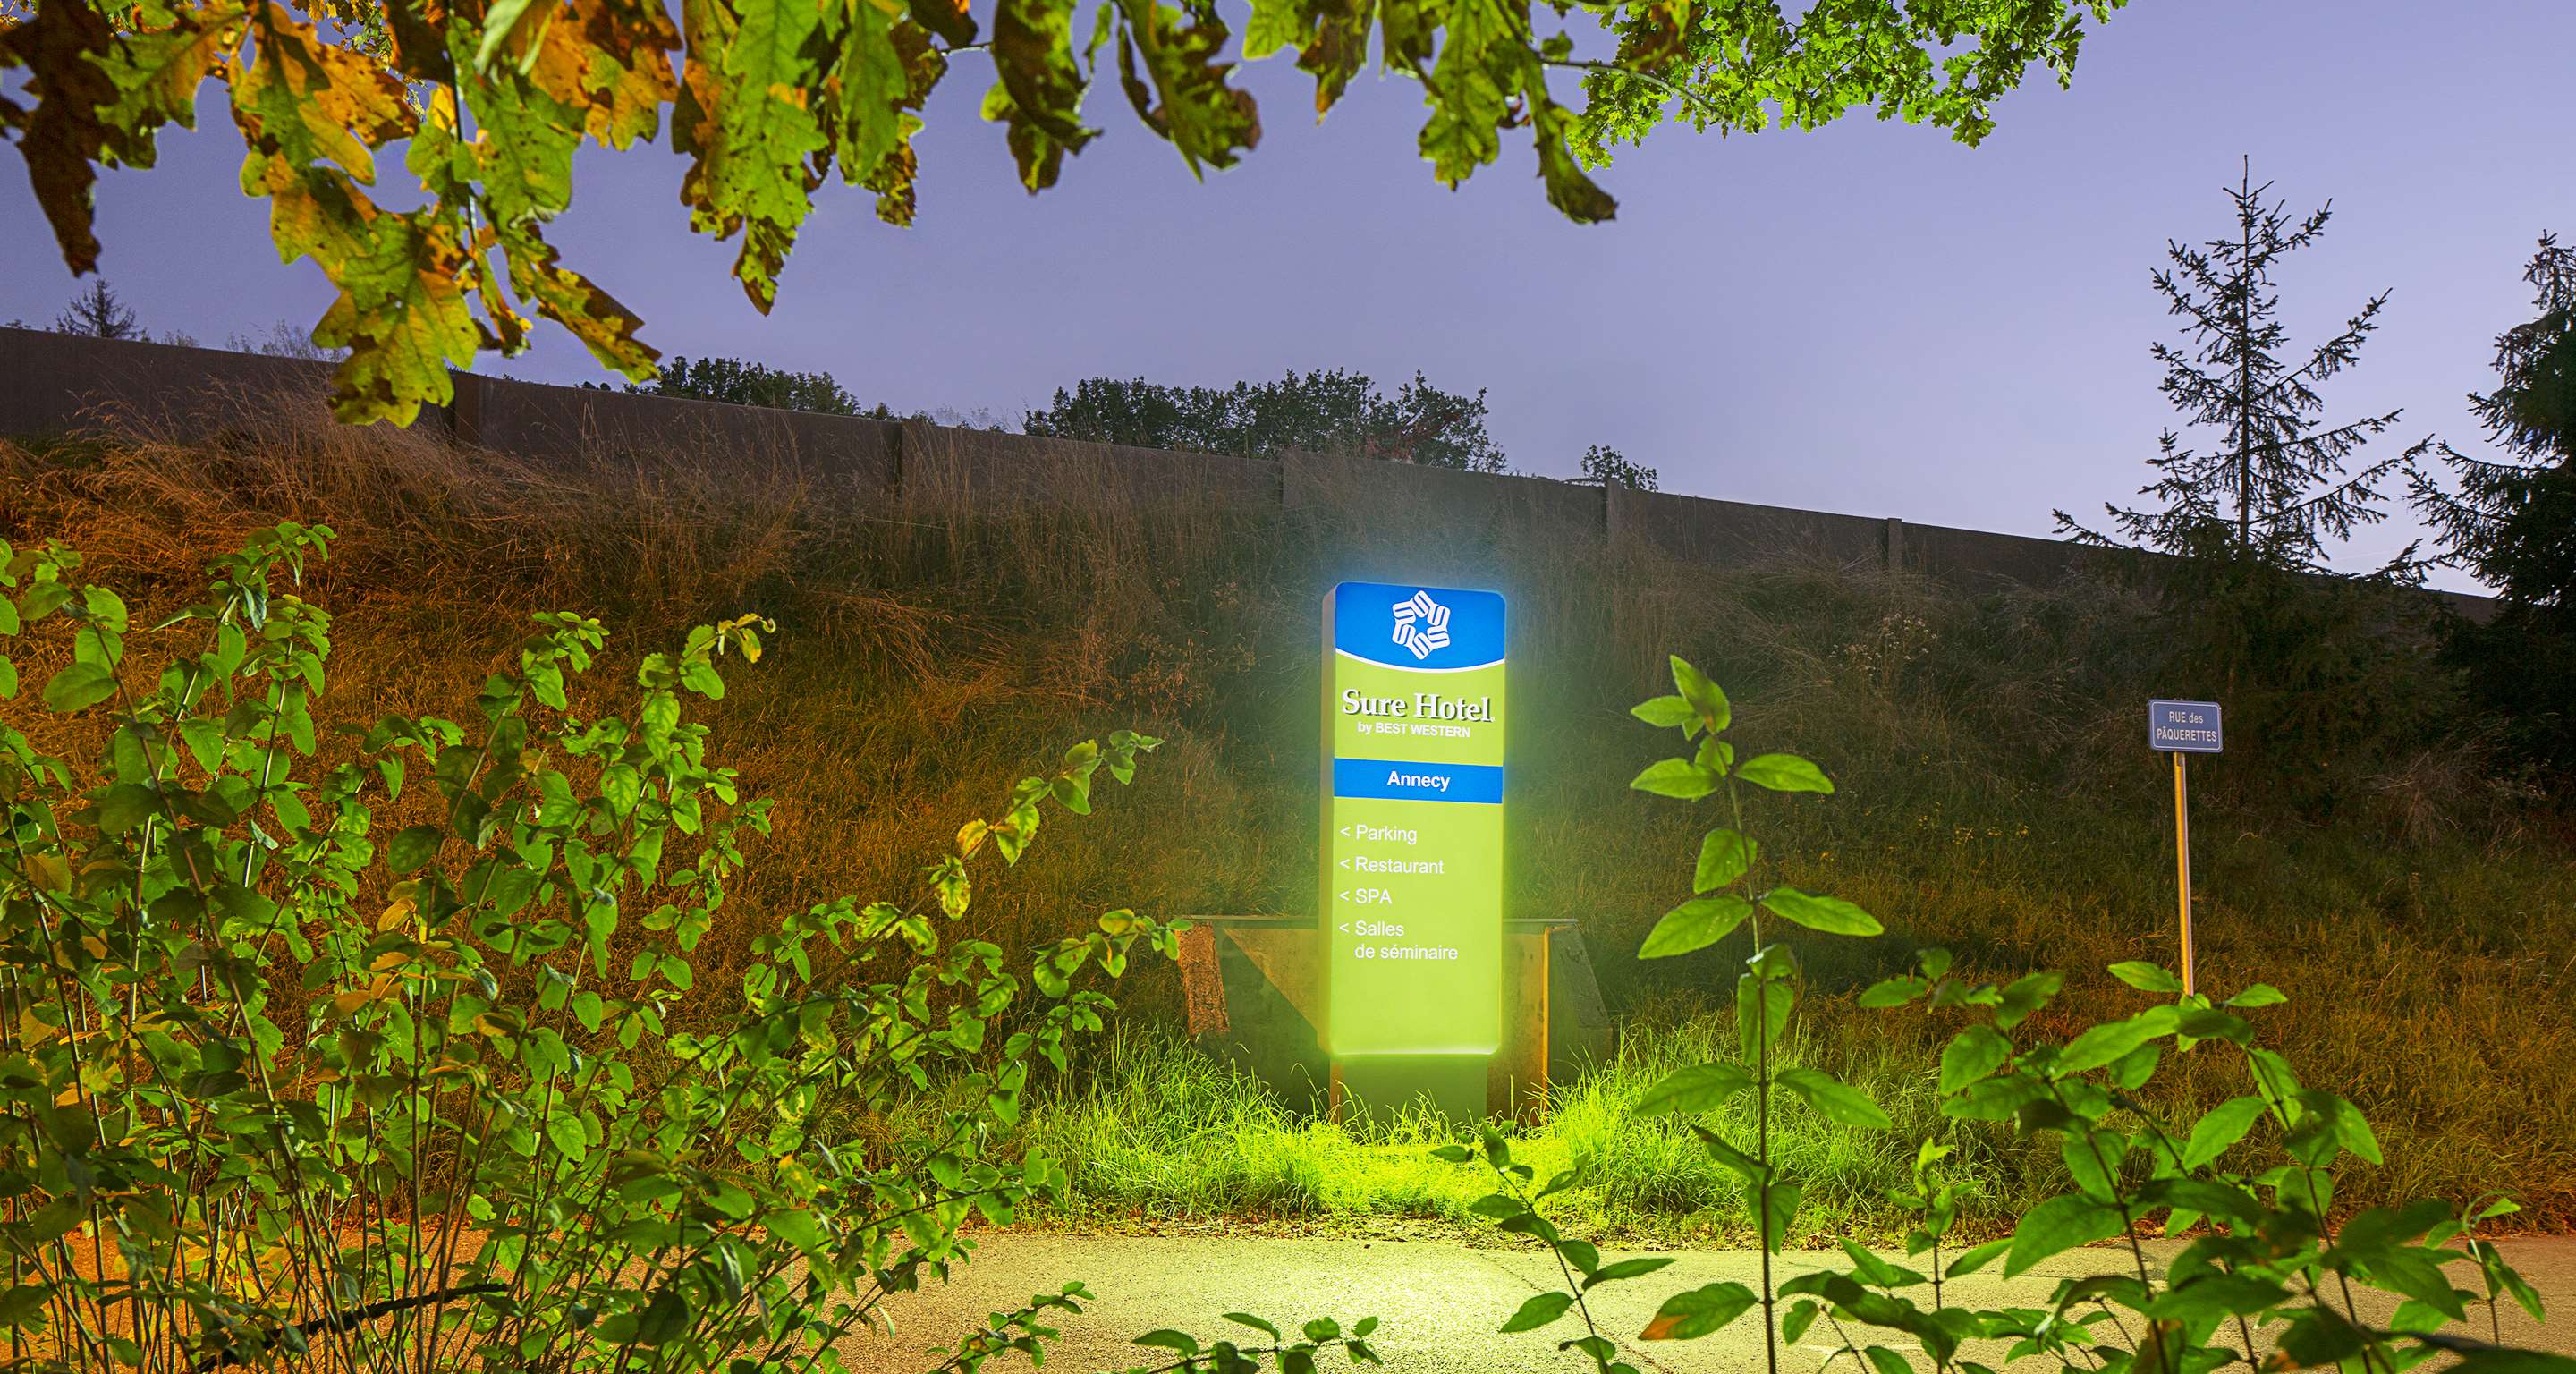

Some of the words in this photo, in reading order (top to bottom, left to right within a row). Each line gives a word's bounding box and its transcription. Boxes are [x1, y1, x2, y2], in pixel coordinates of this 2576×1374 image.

[1342, 688, 1408, 717] Sure
[1414, 692, 1493, 722] Hotel
[2169, 711, 2186, 723] RUE
[2189, 712, 2204, 724] des
[1357, 722, 1372, 735] by
[1375, 723, 1408, 734] BEST
[1411, 725, 1471, 738] WESTERN
[2157, 725, 2217, 742] PÂQUERETTES
[1387, 771, 1451, 792] Annecy
[1356, 824, 1417, 845] Parking
[1355, 856, 1445, 874] Restaurant
[1355, 888, 1393, 904] SPA
[1355, 920, 1404, 937] Salles
[1354, 945, 1375, 959] de
[1380, 945, 1459, 960] séminaire
